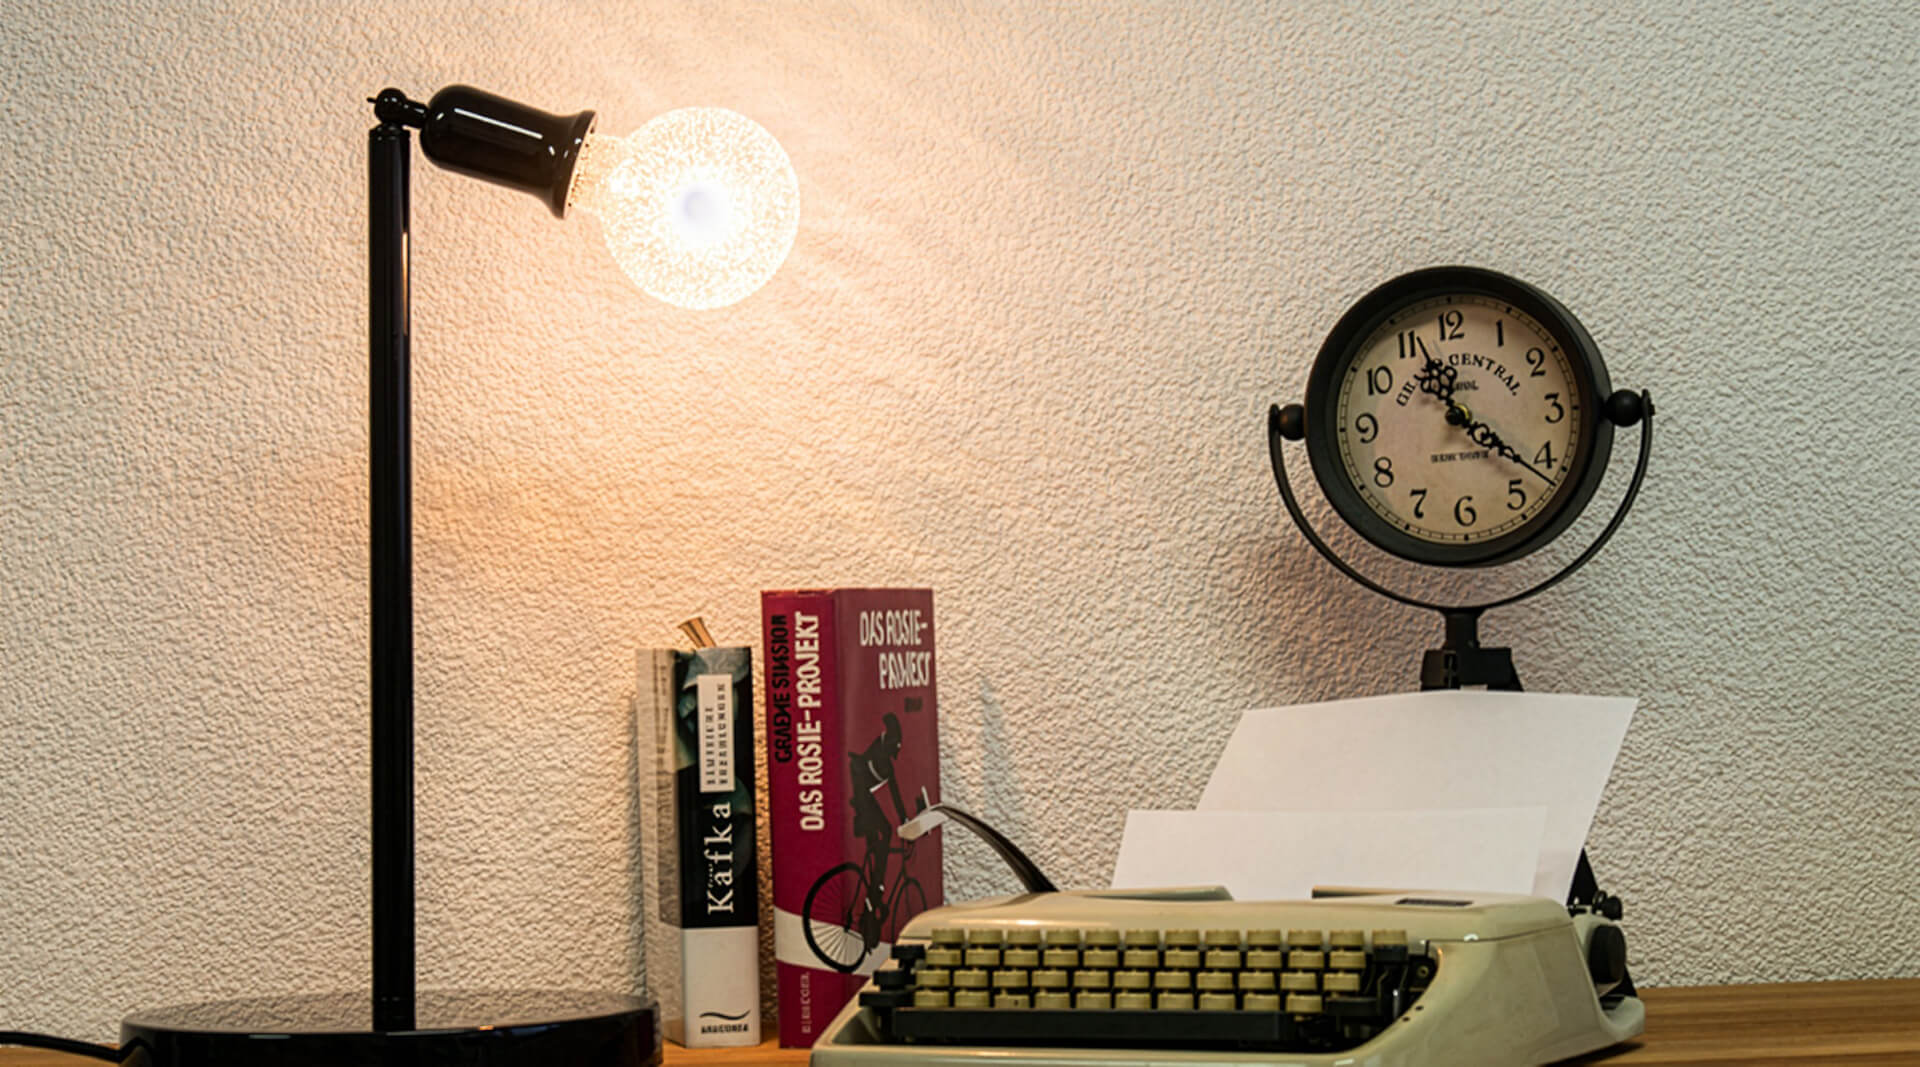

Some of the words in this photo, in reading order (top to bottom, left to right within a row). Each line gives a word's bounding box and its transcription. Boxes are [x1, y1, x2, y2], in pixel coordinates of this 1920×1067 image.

[1438, 310, 1465, 341] 12
[1496, 320, 1504, 347] 1
[1398, 330, 1417, 359] 11
[1449, 353, 1520, 396] CENTRAL
[1526, 347, 1546, 378] 2
[1367, 365, 1393, 396] 10
[1544, 392, 1564, 424] 3
[1355, 412, 1379, 444] 9
[1533, 441, 1557, 469] 4
[1374, 456, 1394, 488] 8
[1410, 488, 1427, 518] 7
[1507, 479, 1527, 510] 5
[1454, 496, 1477, 526] 6
[860, 610, 884, 647] DAS
[771, 615, 790, 689] SIMSION
[795, 611, 823, 785] ROSIE-PROJEKT
[773, 693, 792, 763] GRAEME
[799, 789, 825, 831] DAS
[703, 802, 734, 915] Kafka
